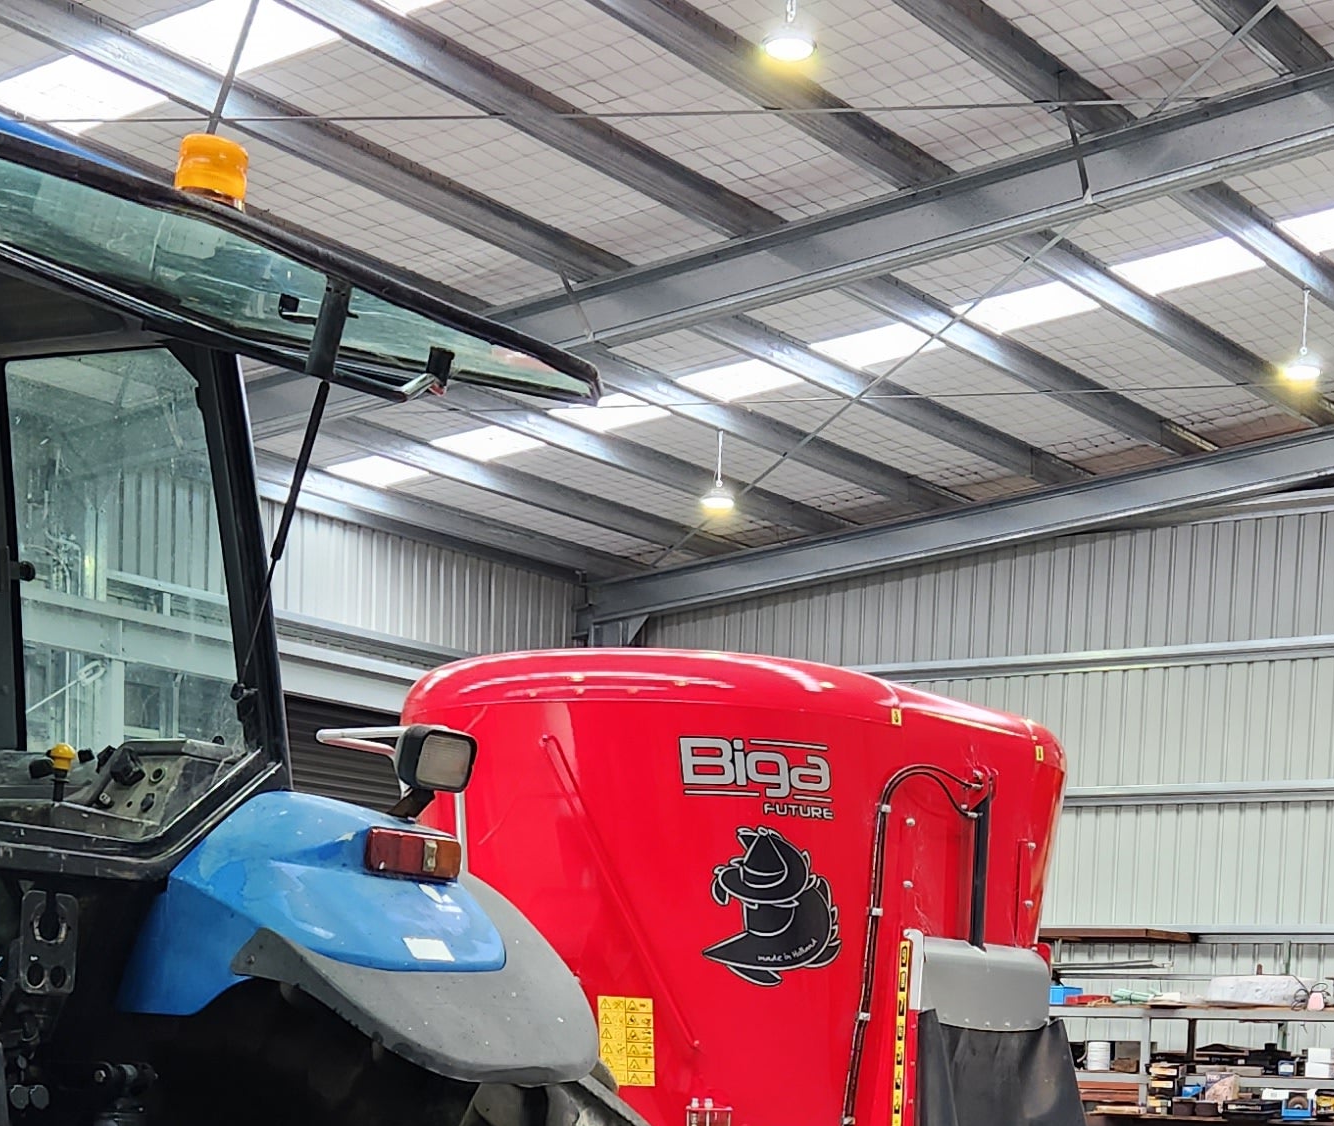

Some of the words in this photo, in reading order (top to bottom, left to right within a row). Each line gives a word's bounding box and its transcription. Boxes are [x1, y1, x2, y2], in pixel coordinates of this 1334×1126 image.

[679, 735, 832, 798] Biga
[763, 802, 835, 820] FUTURE
[757, 953, 783, 962] made
[791, 937, 818, 958] Holland
